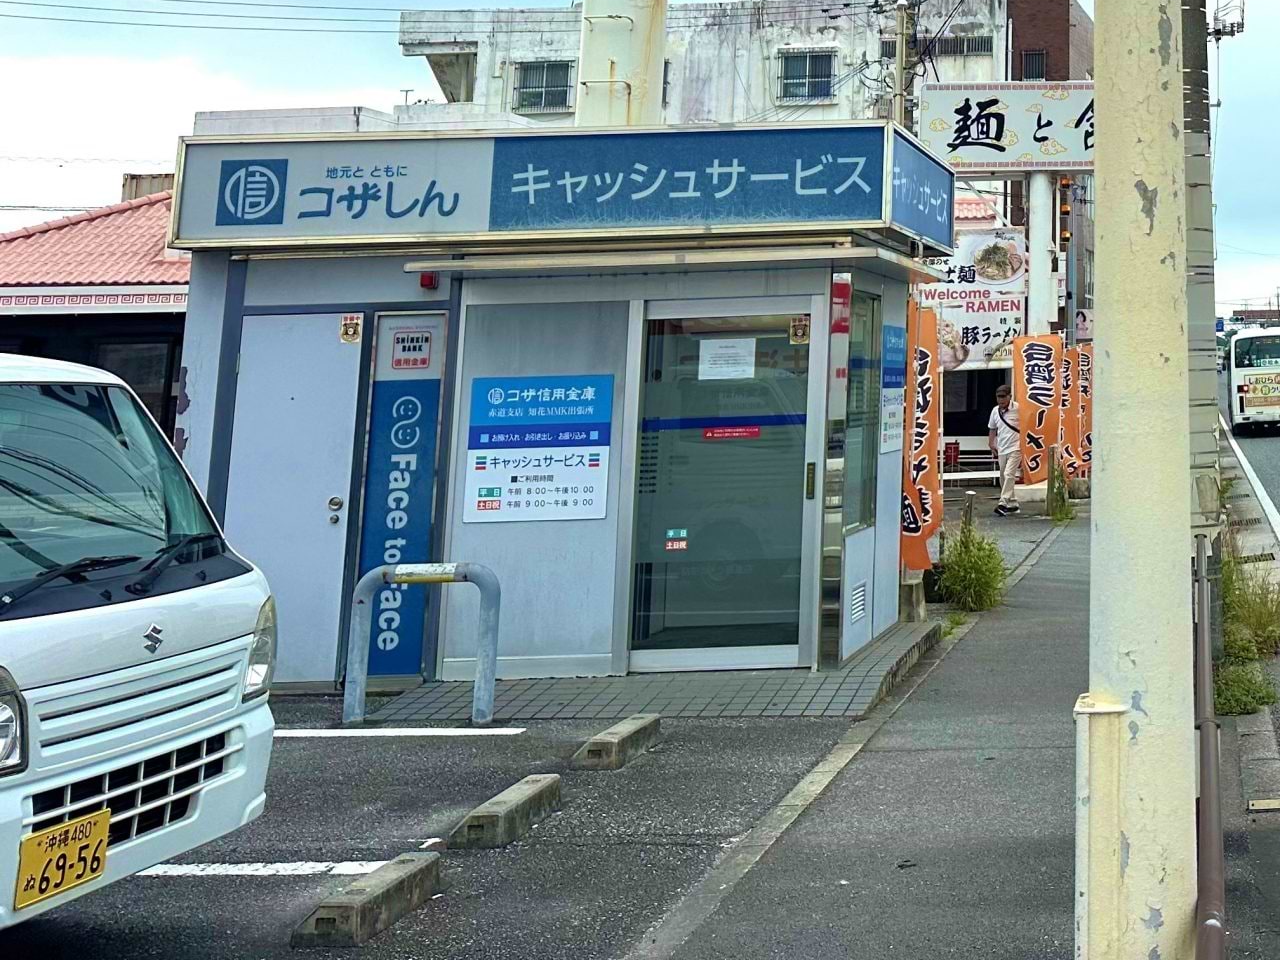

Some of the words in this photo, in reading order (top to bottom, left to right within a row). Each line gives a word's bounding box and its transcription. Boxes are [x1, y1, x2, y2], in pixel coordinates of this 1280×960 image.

[511, 153, 872, 205] キャッシュサービス
[297, 180, 460, 220] コザしん
[924, 288, 991, 301] Welcome
[965, 300, 1021, 313] RAMEN
[402, 344, 423, 352] BANK
[507, 386, 597, 402] コザ信用金庫
[489, 453, 586, 469] キャッシュサービス
[386, 454, 417, 529] Face
[383, 536, 407, 565] to
[376, 581, 408, 652] ace
[38, 838, 103, 895] 69-56
